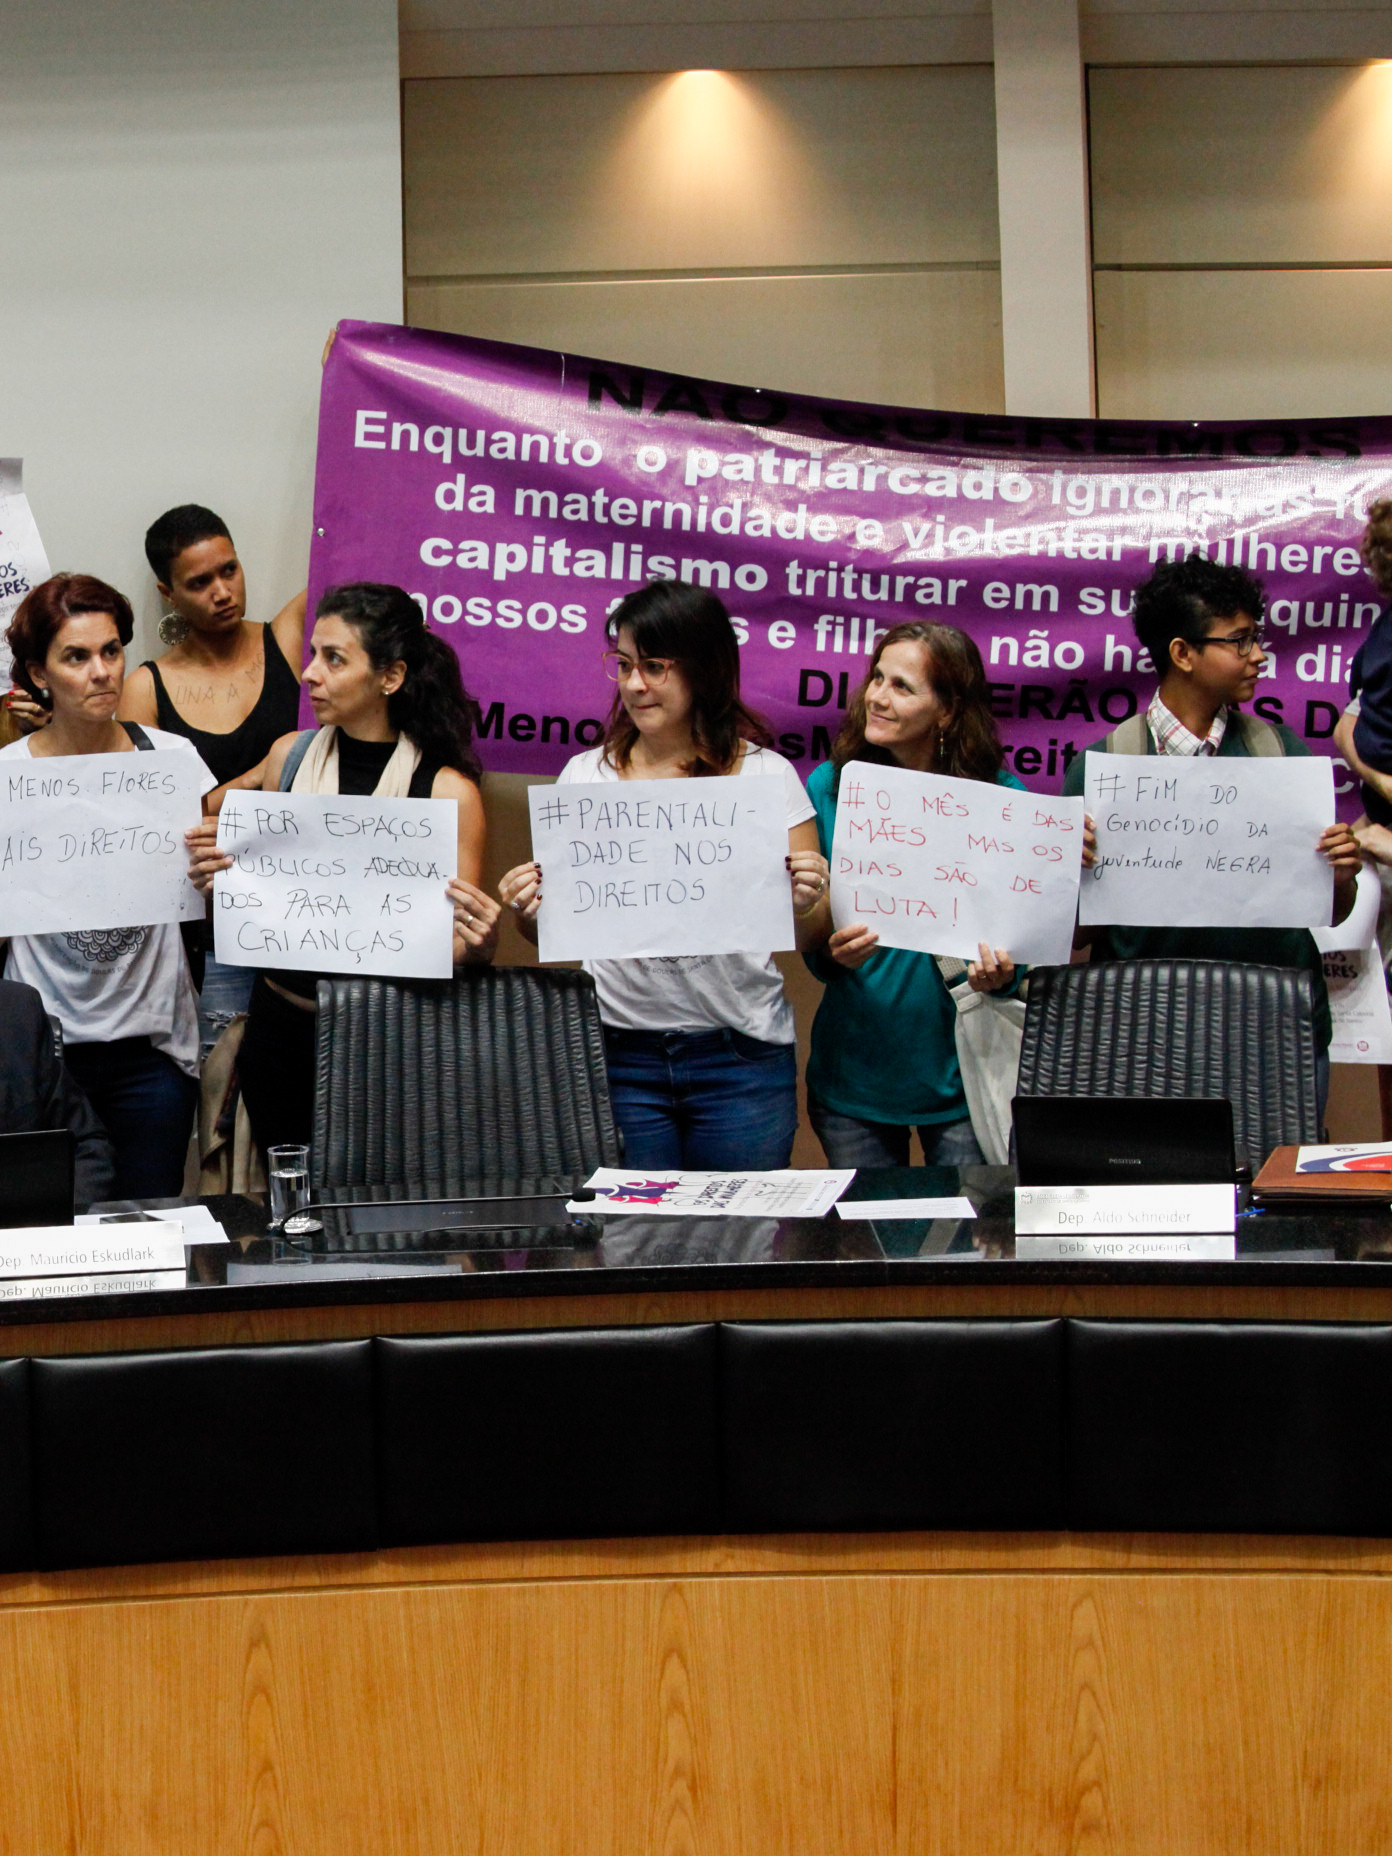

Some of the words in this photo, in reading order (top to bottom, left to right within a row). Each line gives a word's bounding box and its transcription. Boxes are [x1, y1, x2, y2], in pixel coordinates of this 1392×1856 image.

[821, 406, 1362, 462] QUEREMOS
[354, 409, 603, 467] Enquanto
[637, 444, 667, 473] o
[685, 446, 1033, 503] patriarcado
[1050, 470, 1242, 517] ignorar
[1260, 490, 1313, 517] as
[434, 474, 495, 514] da
[514, 486, 837, 543] maternidade
[856, 518, 882, 547] e
[902, 514, 1131, 562] violentar
[1147, 531, 1375, 577] mulhere
[419, 536, 769, 591] capitalismo
[786, 560, 967, 606] triturar
[982, 582, 1059, 612] em
[768, 620, 796, 649] e
[989, 629, 1085, 670] não
[469, 700, 605, 747] Meno
[922, 792, 970, 817] MÊS
[1002, 802, 1015, 822] É
[1032, 809, 1074, 831] DAS
[1209, 784, 1238, 804] DO
[323, 812, 432, 842] ESPAÇOS
[849, 817, 926, 846] MÃES
[968, 833, 1015, 853] MAS
[1031, 845, 1063, 862] OS
[1246, 821, 1268, 838] DA
[222, 848, 346, 877] PÚBLICOS
[569, 839, 648, 867] DADE
[675, 838, 732, 865] NOS
[1205, 850, 1271, 875] NEGRA
[839, 856, 903, 877] DIAS
[933, 861, 978, 887] SÃO
[1010, 875, 1043, 894] DE
[218, 891, 263, 909] DOS
[285, 888, 351, 920] PARA
[380, 893, 411, 916] AS
[573, 879, 706, 913] DIREITOS
[237, 921, 404, 964] CRIANÇAS
[1093, 1211, 1122, 1223] Aldo
[1127, 1210, 1191, 1224] Schneider
[30, 1251, 87, 1267] Mauricio
[92, 1246, 155, 1264] Eskudlark
